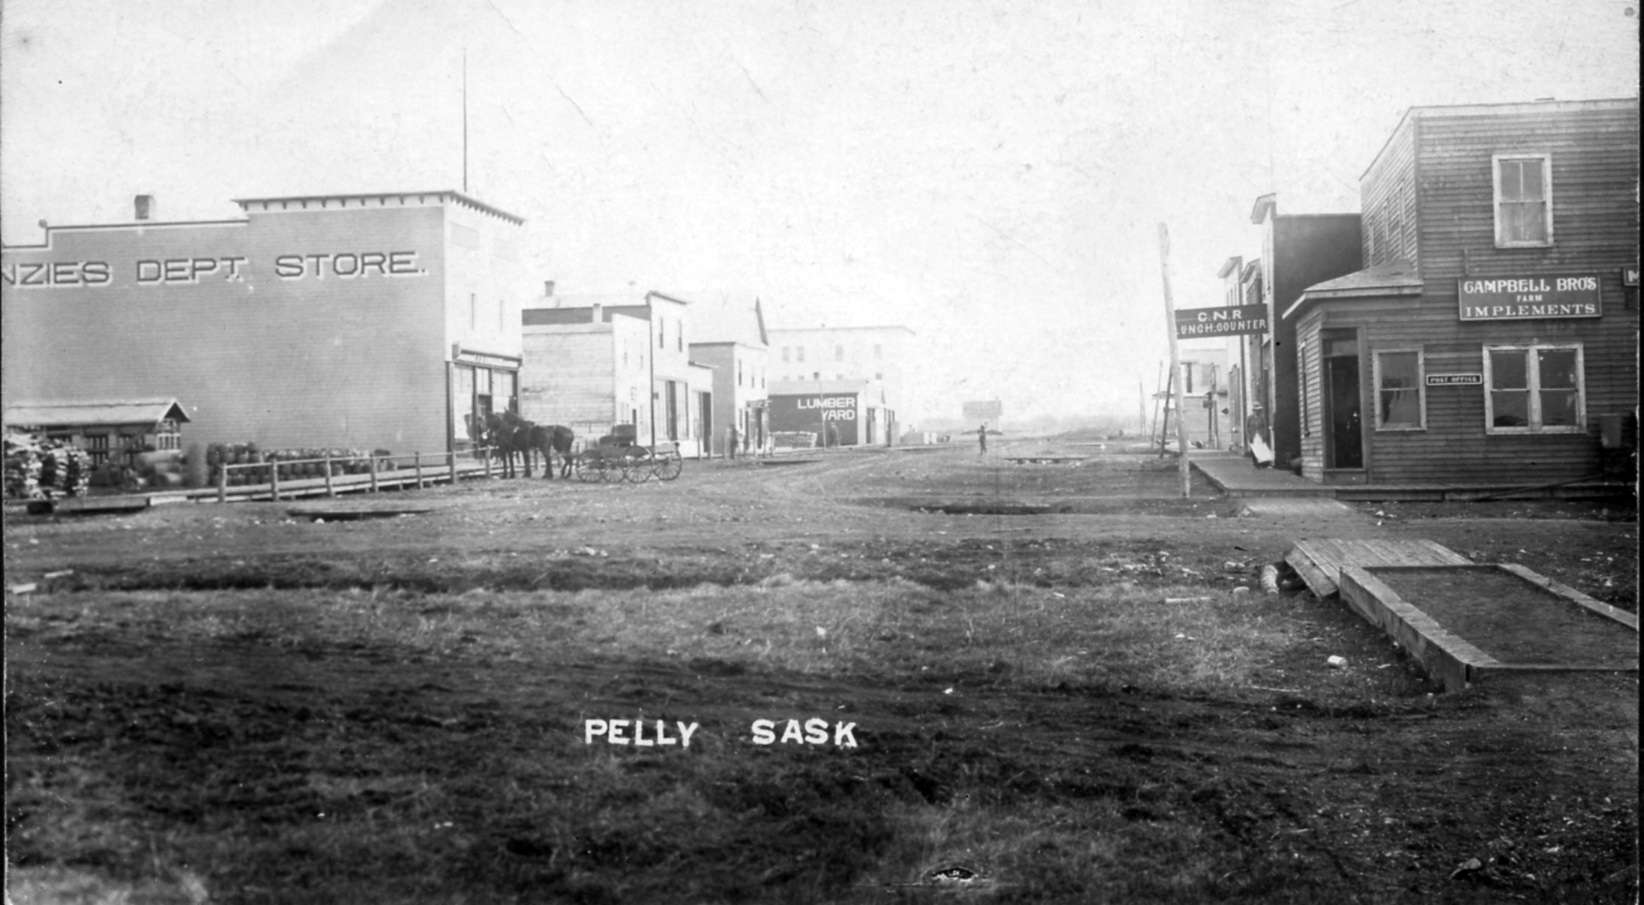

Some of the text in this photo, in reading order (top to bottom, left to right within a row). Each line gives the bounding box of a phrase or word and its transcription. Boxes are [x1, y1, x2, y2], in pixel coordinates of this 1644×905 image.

[1463, 278, 1551, 294] CAMPBELL
[1516, 294, 1543, 302] FARM
[1465, 303, 1596, 317] IMPLEMENTS
[1430, 375, 1477, 384] POST OFFICE
[797, 397, 855, 409] LUMBER
[822, 409, 855, 420] YARD
